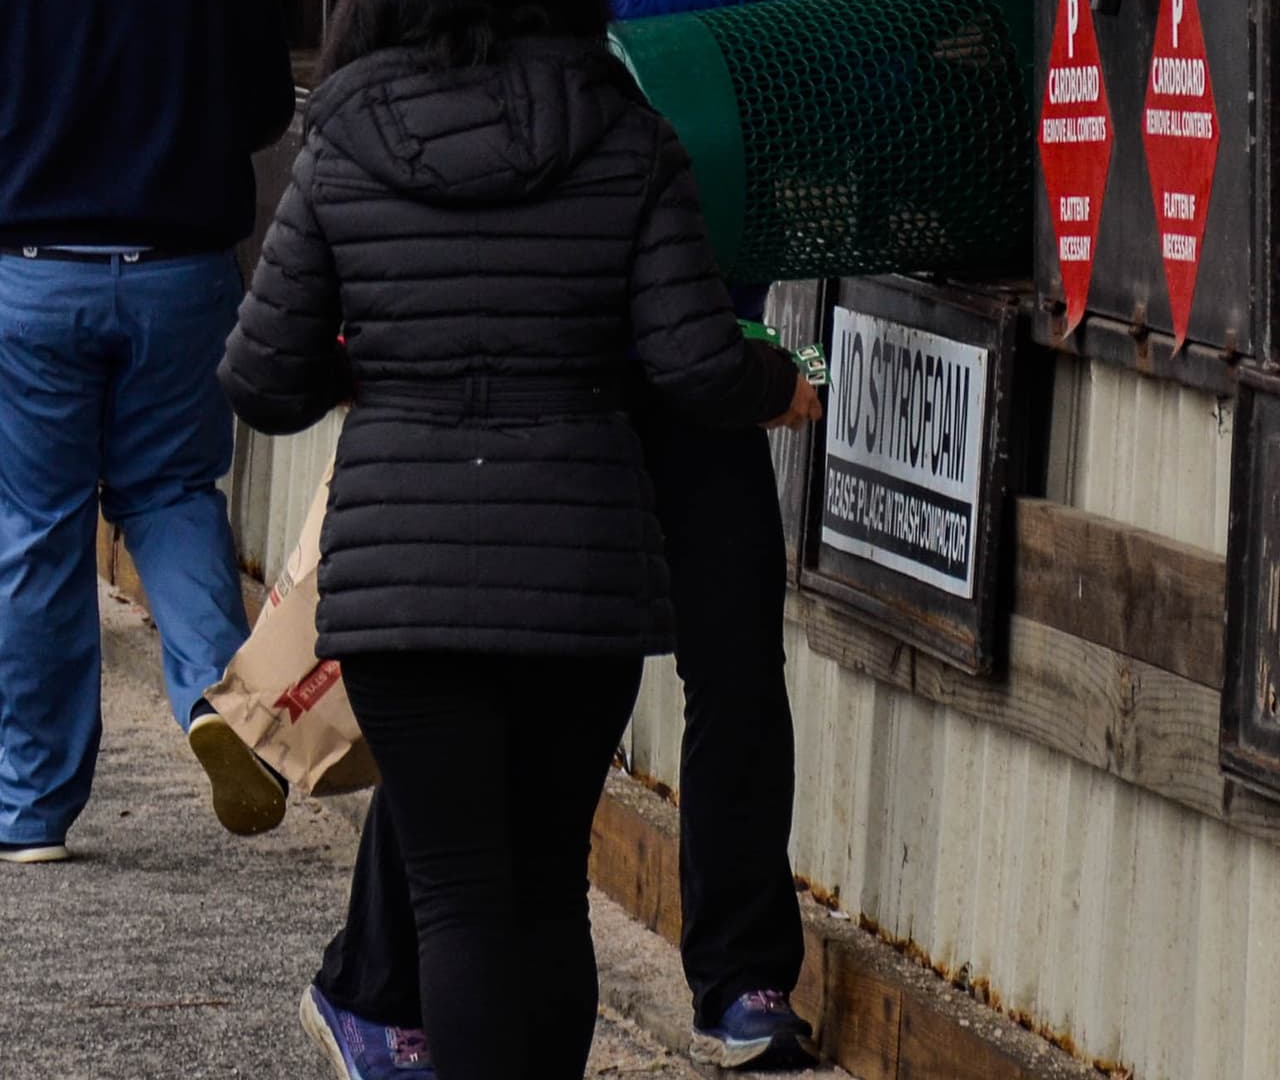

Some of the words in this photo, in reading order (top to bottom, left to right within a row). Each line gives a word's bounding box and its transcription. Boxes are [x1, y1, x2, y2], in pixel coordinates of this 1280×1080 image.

[1048, 66, 1099, 105] CARDBOARD
[1152, 57, 1206, 97] CARDBOARD
[1043, 118, 1066, 144] REMOVE
[1066, 117, 1077, 143] ALL
[1077, 115, 1107, 142] CONTENTS
[1146, 108, 1170, 135] REMOVE
[1171, 110, 1182, 136] ALL
[1182, 111, 1213, 139] CONTENTS
[1060, 196, 1084, 222] FLATTEN
[1084, 196, 1090, 221] IF
[1163, 191, 1189, 220] FLATTEN
[1189, 194, 1196, 222] IF
[1059, 236, 1091, 262] NECESSARY
[1162, 233, 1197, 263] NECESSARY
[835, 329, 864, 448] NO
[865, 334, 970, 484] STYROFOAM
[827, 466, 855, 522] PLEASE
[856, 477, 884, 531] PLACE
[884, 490, 893, 534] IN
[893, 491, 920, 544] TRASH
[919, 501, 967, 564] COMPACTOR
